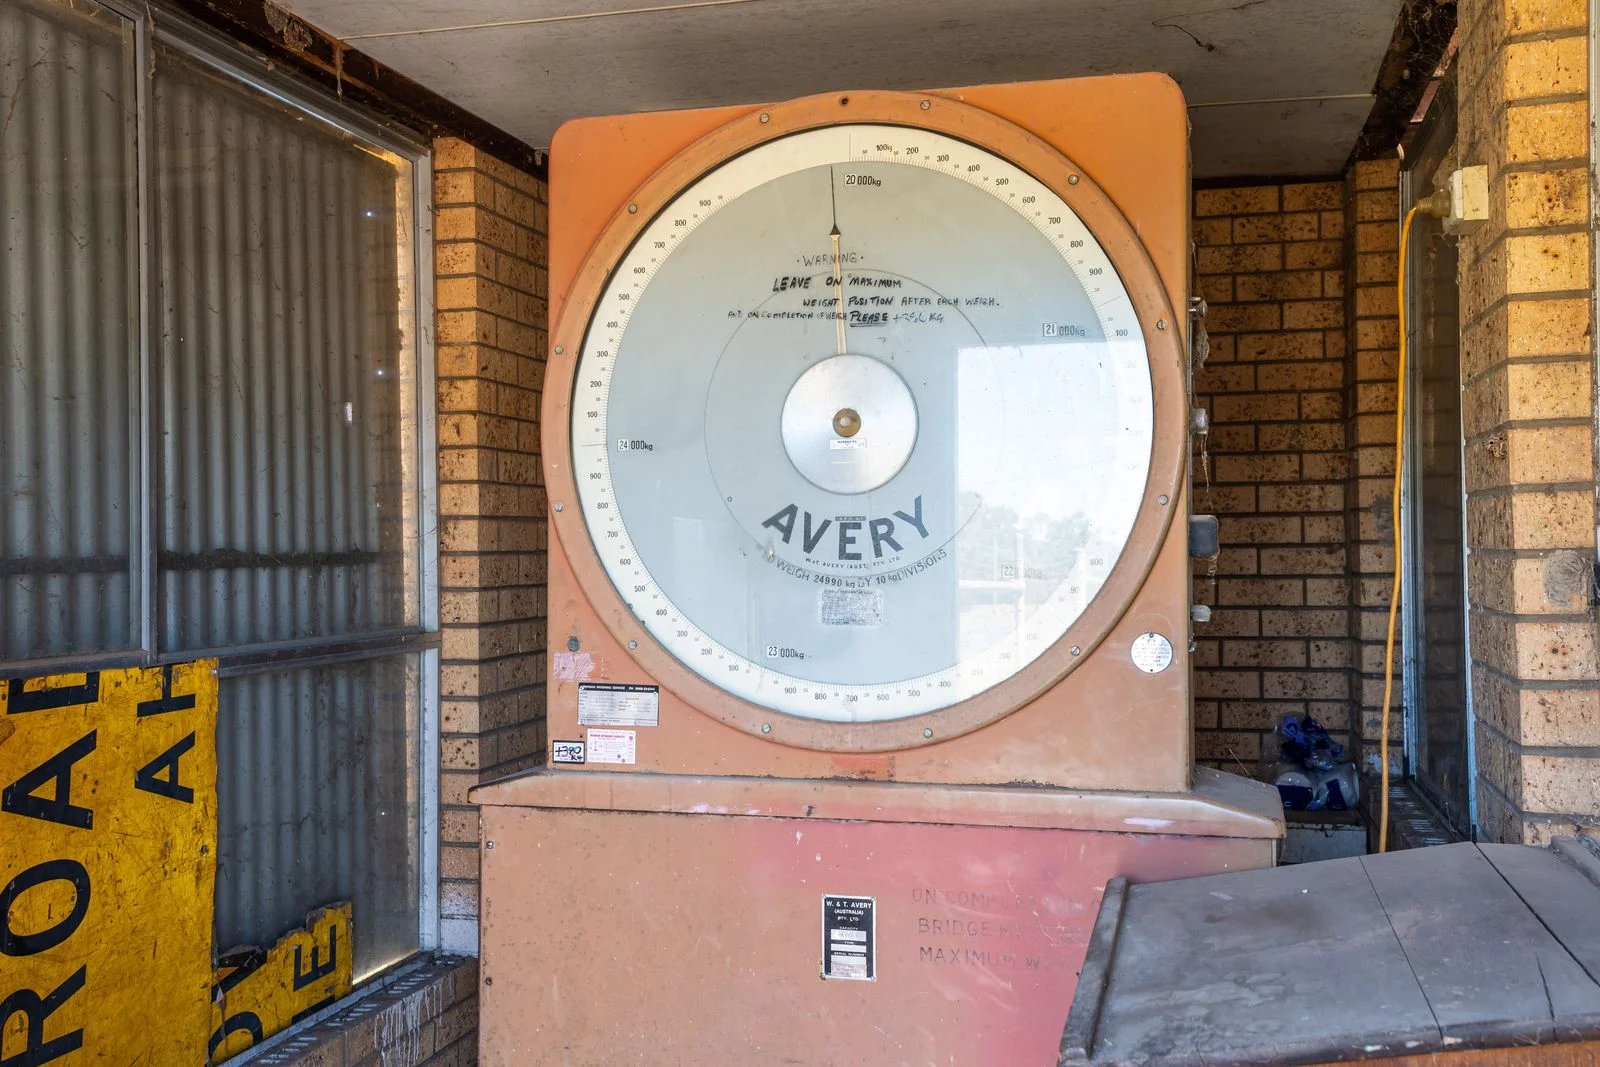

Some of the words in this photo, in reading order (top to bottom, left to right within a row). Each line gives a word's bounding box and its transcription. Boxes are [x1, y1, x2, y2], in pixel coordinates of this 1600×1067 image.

[773, 276, 811, 292] LEAVE
[826, 276, 842, 286] ON
[849, 277, 901, 288] MAXIMUM
[848, 296, 894, 306] POSITION
[850, 310, 888, 324] PLEASE
[761, 494, 930, 560] AVERY
[776, 560, 810, 580] WEIGH
[814, 574, 842, 587] 24990
[876, 576, 886, 585] 10
[918, 918, 992, 936] BRIDGE
